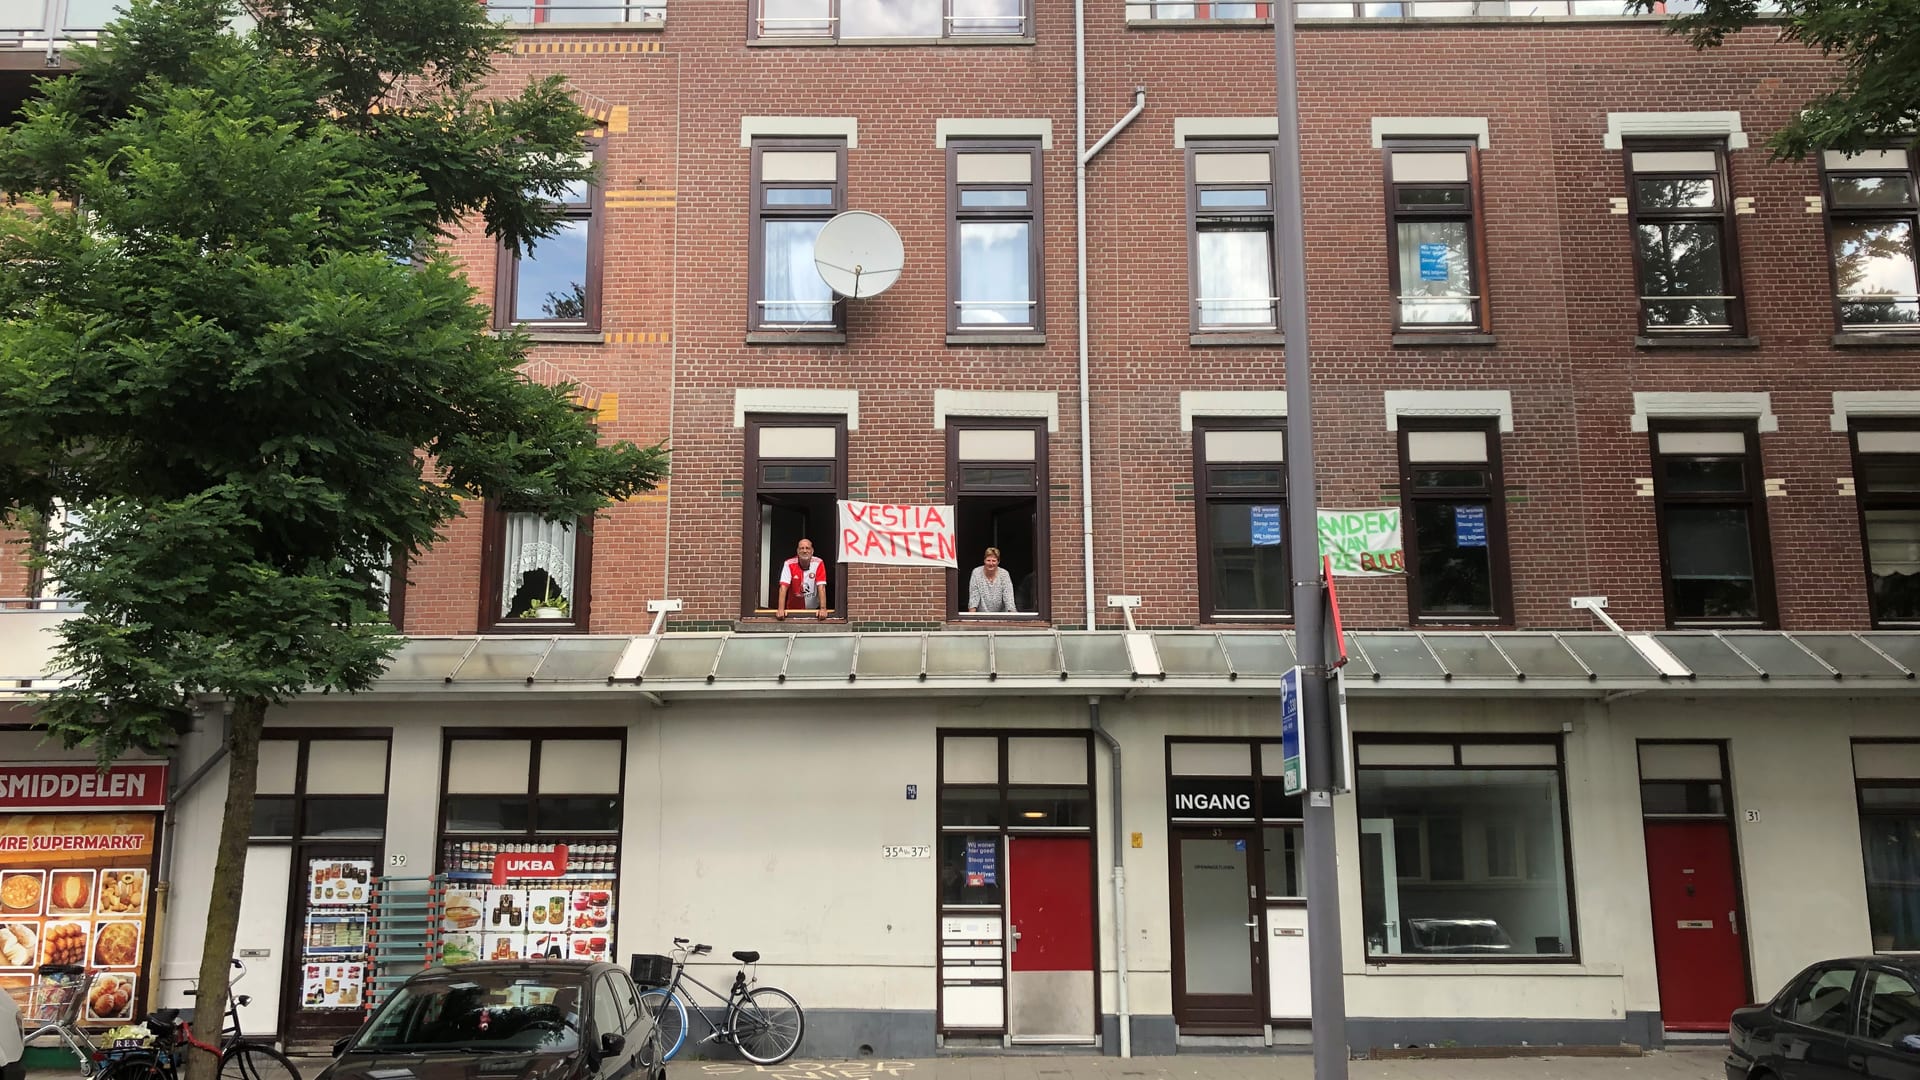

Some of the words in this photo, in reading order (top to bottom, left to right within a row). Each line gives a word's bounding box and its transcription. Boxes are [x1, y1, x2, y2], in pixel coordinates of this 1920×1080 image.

[847, 502, 946, 529] VESTIA
[843, 529, 955, 560] RATTEN
[1175, 794, 1251, 810] INGANG
[1747, 811, 1759, 821] 31
[31, 834, 144, 851] SUPERMARKT
[391, 855, 405, 866] 39
[506, 860, 555, 871] UKBA
[116, 1040, 138, 1048] REX
[701, 1061, 916, 1075] SLOOP
